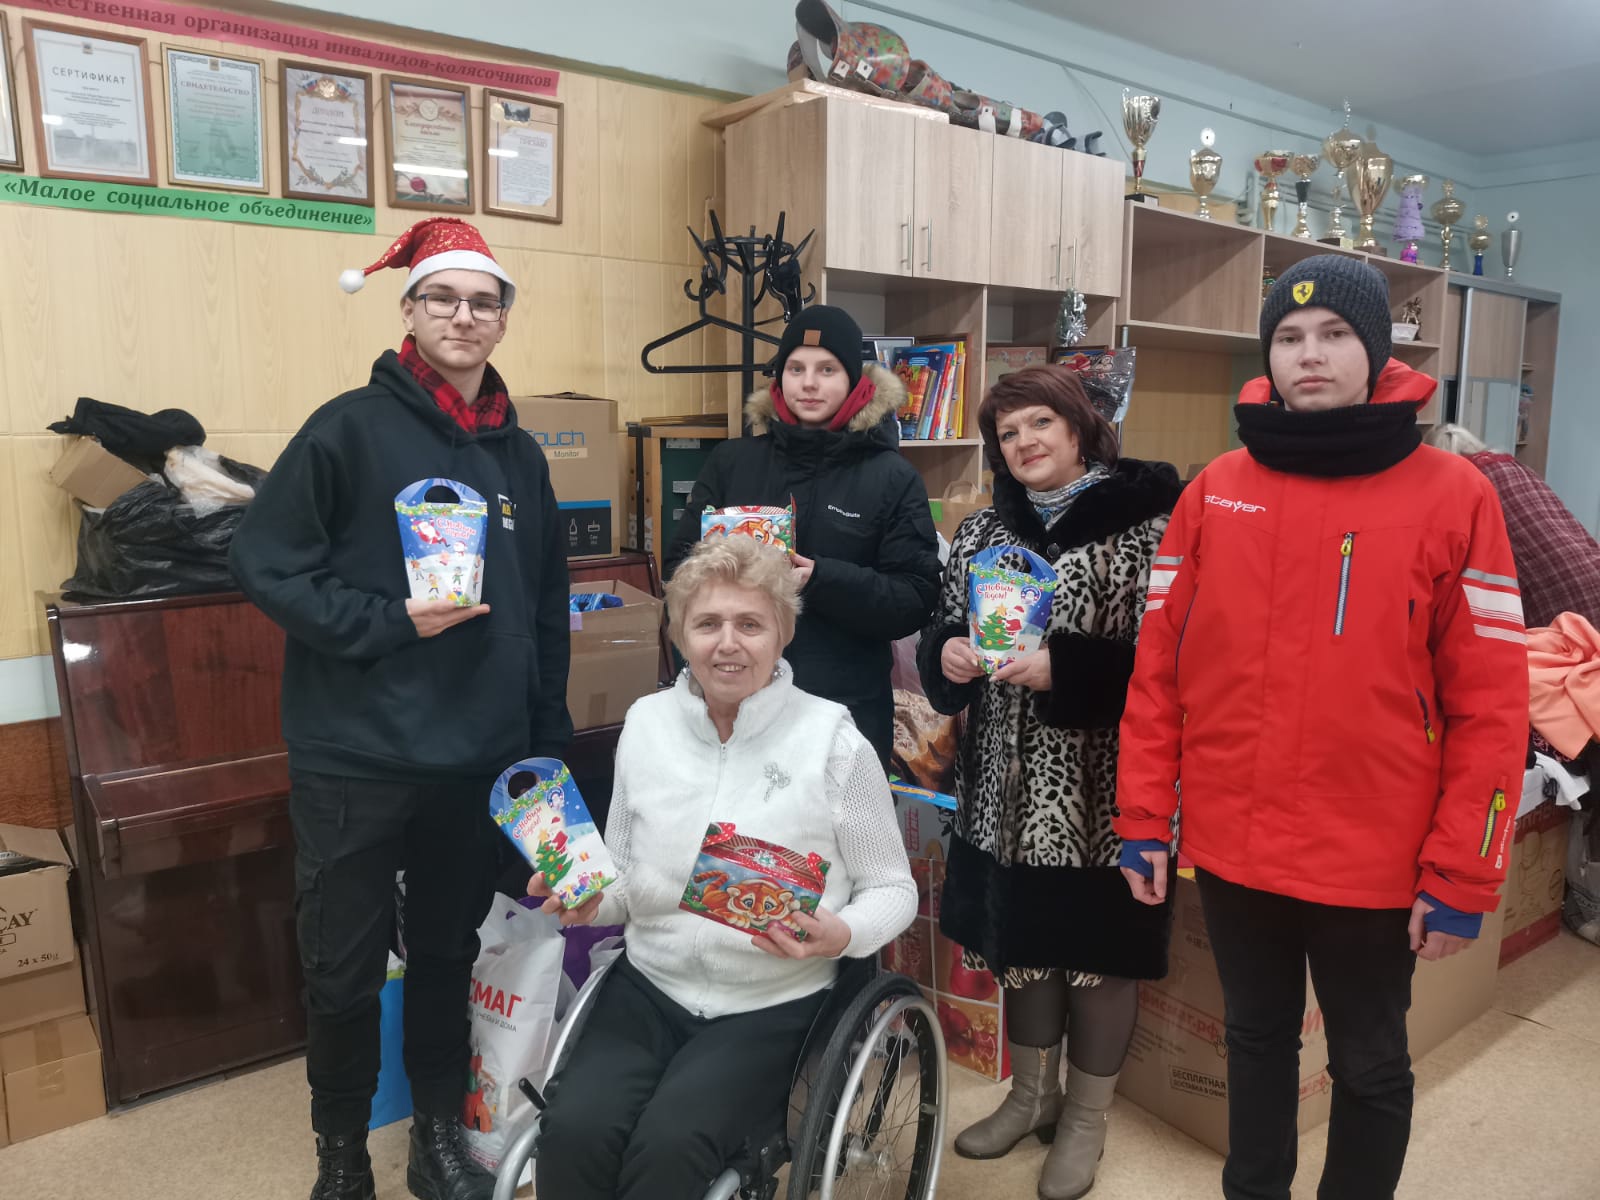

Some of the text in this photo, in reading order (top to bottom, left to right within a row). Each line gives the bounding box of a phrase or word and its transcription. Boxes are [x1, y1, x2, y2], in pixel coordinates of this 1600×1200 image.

[184, 14, 320, 50] организация
[325, 41, 552, 88] инвалидов-колясочников
[51, 66, 126, 85] СЕРТИФИКАТ
[180, 81, 250, 96] СВИДЕТЕЛЬСТВО
[4, 178, 373, 226] «Малое социальное объединение»
[524, 429, 585, 446] ouch
[553, 450, 580, 458] Monitor
[1204, 495, 1266, 513] stayer
[17, 958, 29, 968] 24
[1171, 1068, 1227, 1090] БЕСПЛАТНАЯ
